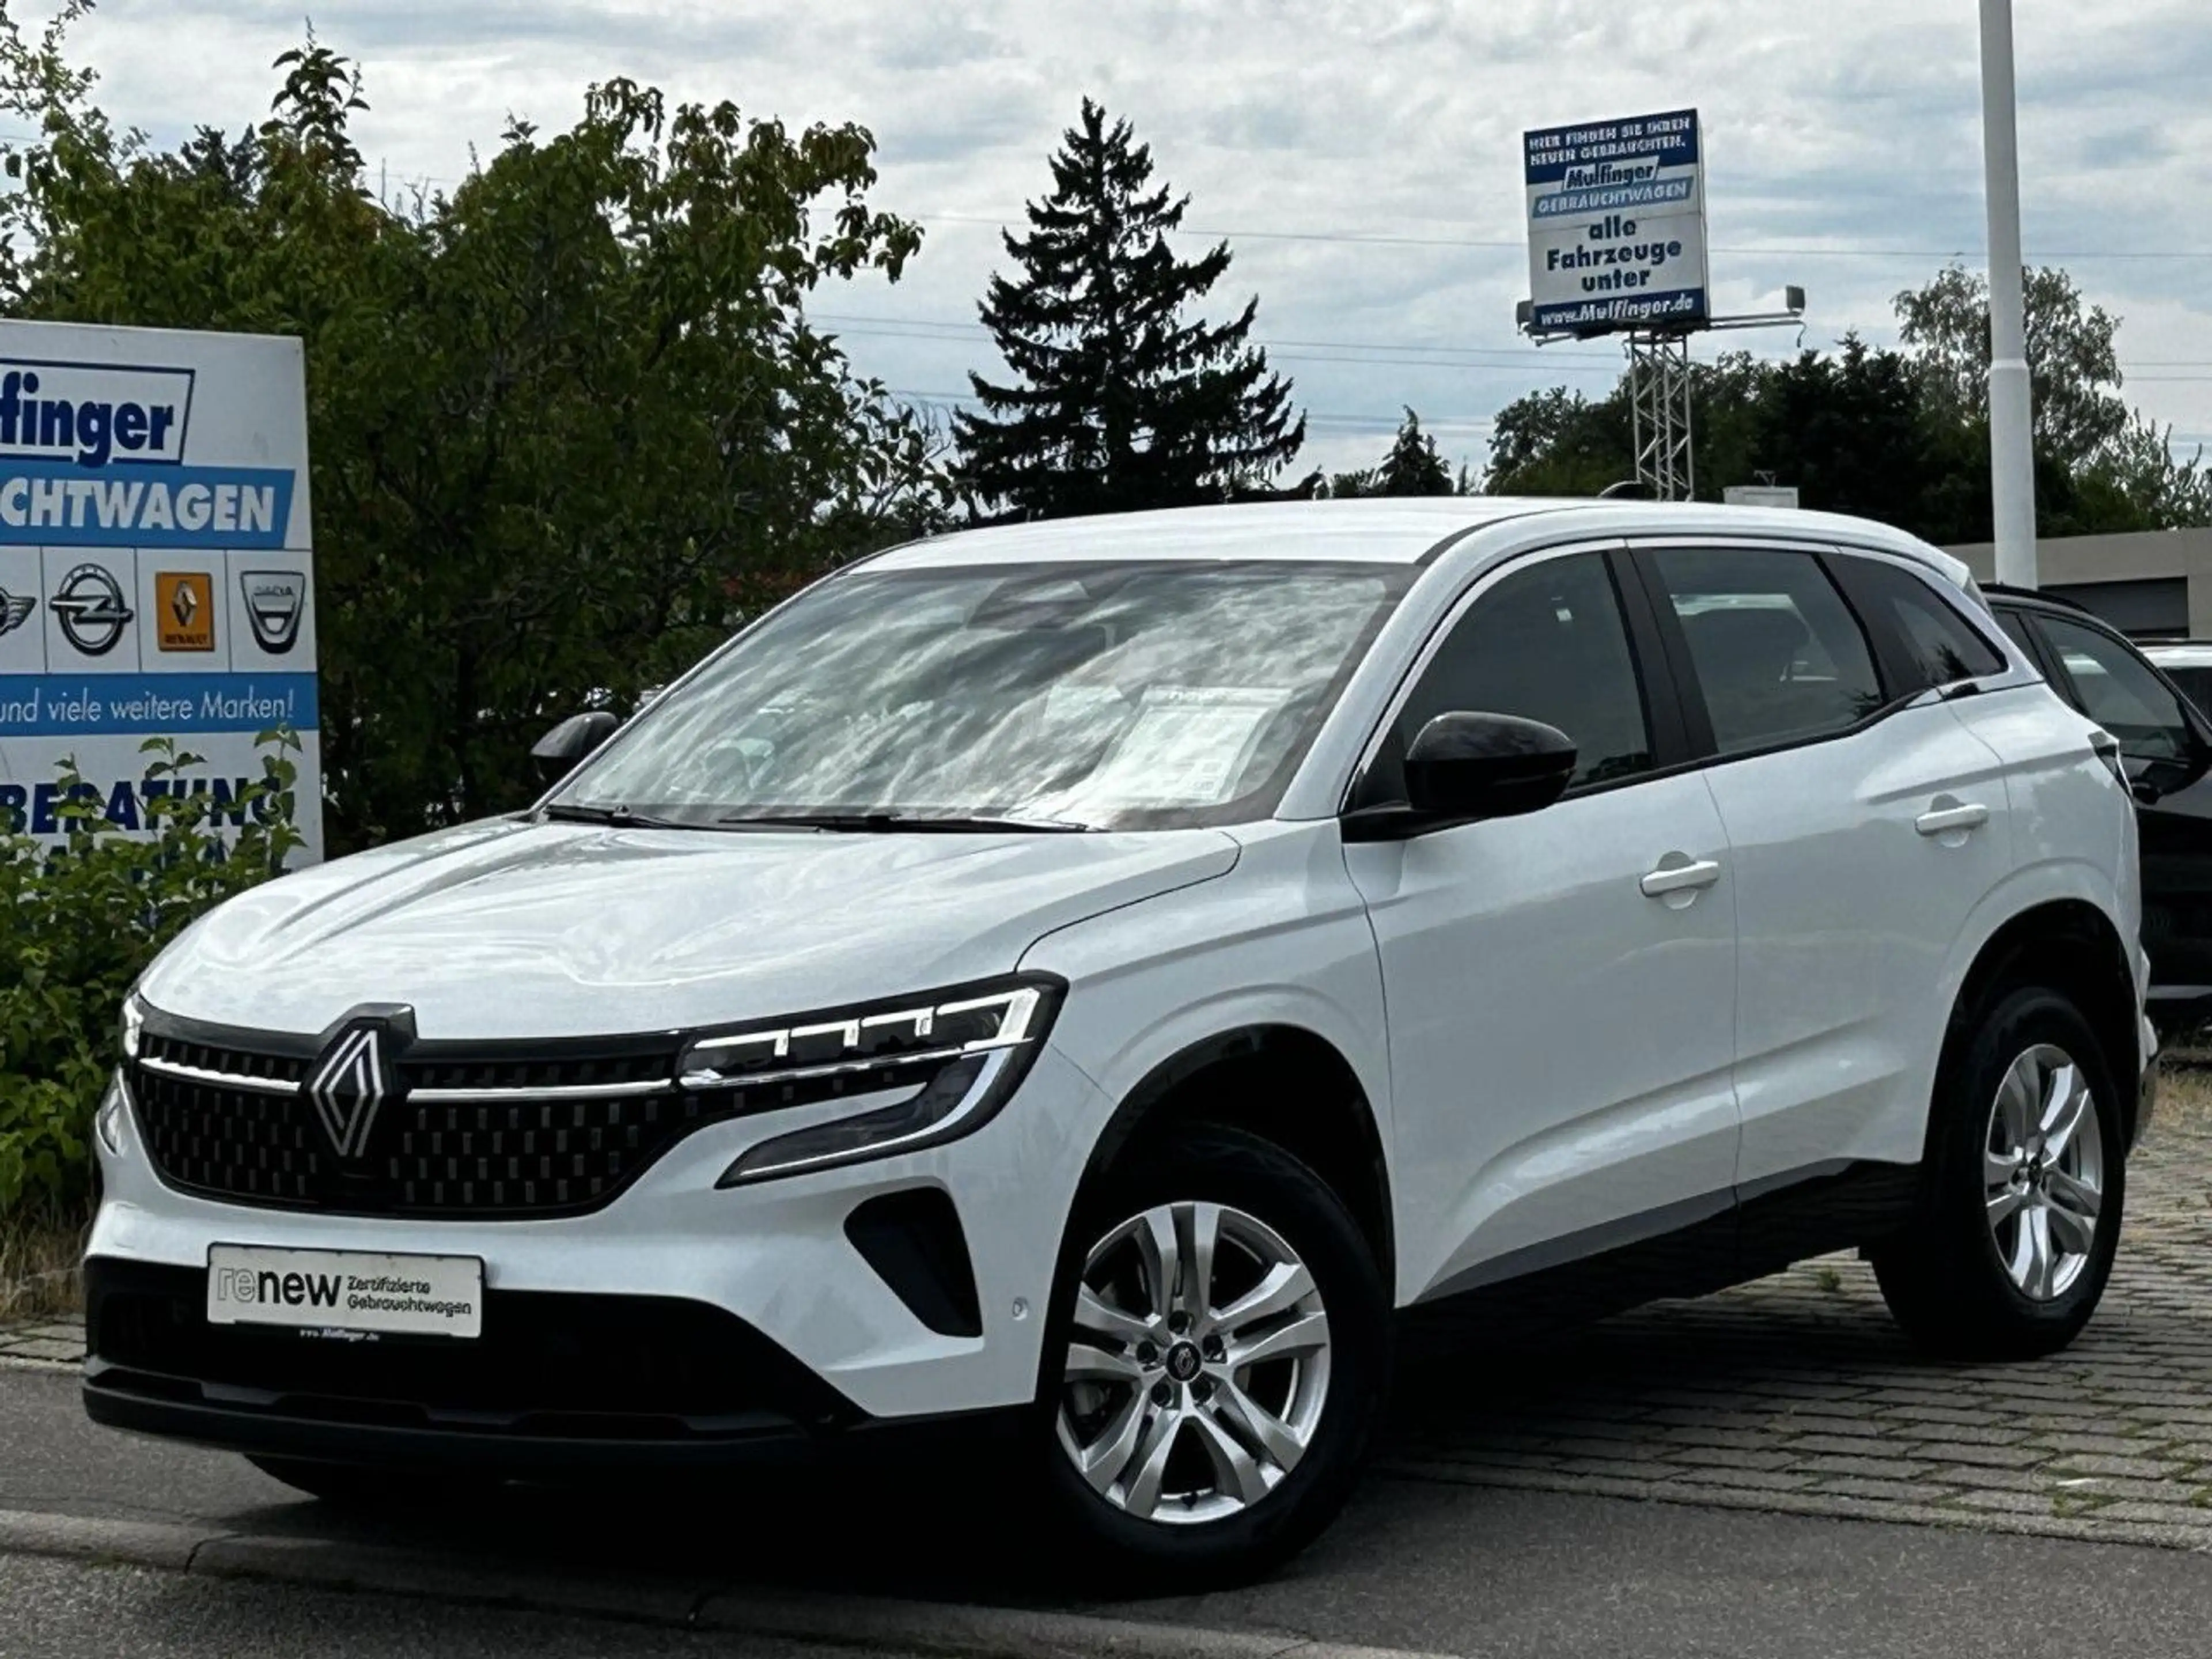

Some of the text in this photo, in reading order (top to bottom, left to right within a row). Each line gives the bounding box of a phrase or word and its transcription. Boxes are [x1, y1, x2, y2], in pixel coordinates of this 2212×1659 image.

[1529, 117, 1691, 151] HIER FINDEN SIE IHREN
[1530, 147, 1576, 166] NEUEN
[1565, 164, 1654, 190] Mulfinger
[1537, 181, 1687, 214] GEBRAUCHTWAGEN
[1588, 215, 1637, 240] alle
[1547, 240, 1682, 271] Fahrzeuge
[1581, 268, 1652, 292] unter
[1540, 293, 1694, 326] www.Mulfinger.de
[0, 477, 275, 532] CHTWAGEN
[0, 685, 294, 722] und viele weitere Marken!
[217, 1268, 341, 1307] renew
[347, 1275, 431, 1294] Zertifizierte
[347, 1294, 472, 1317] Gebrauchtwagen
